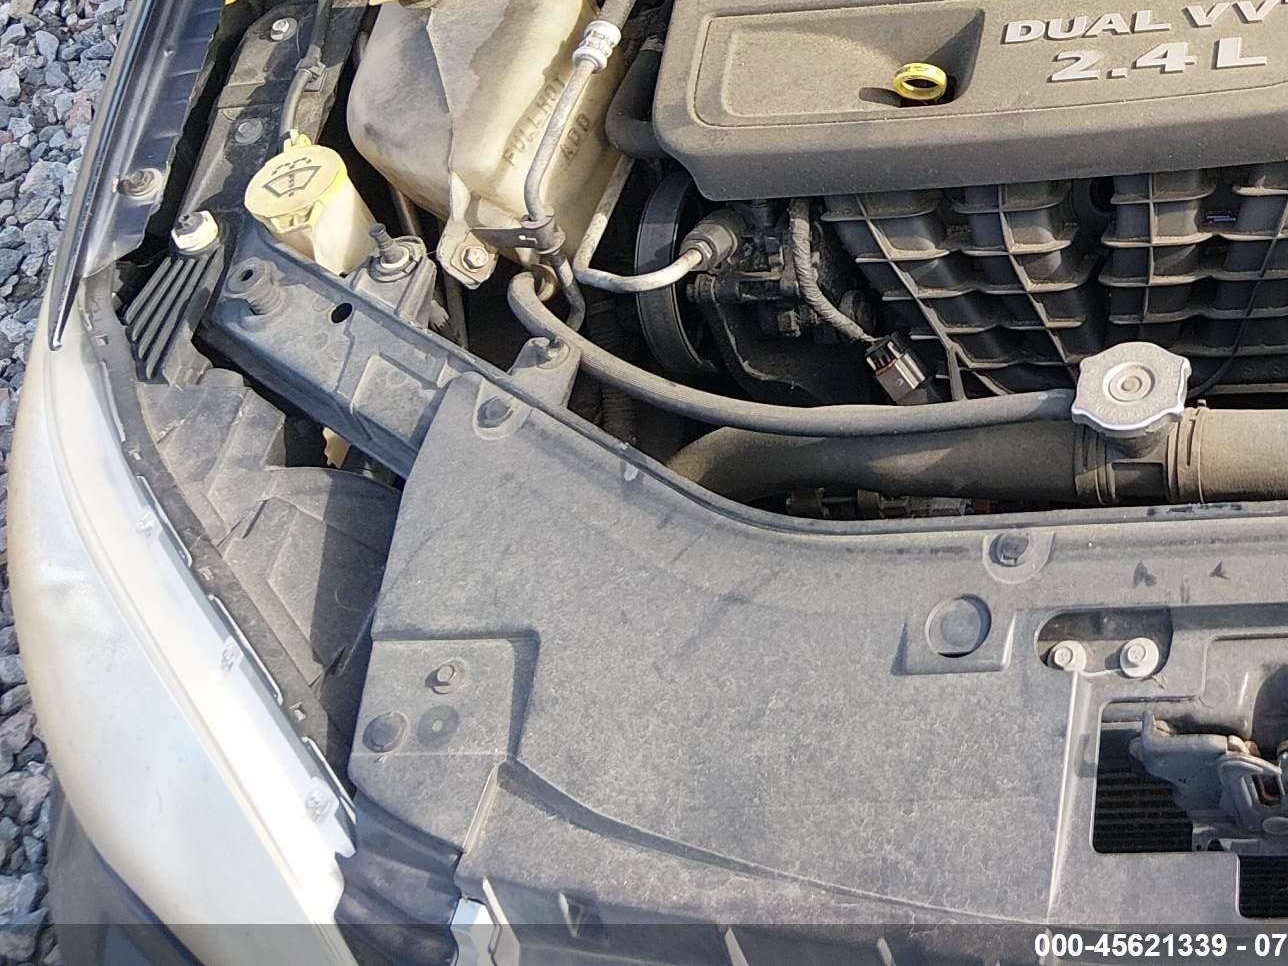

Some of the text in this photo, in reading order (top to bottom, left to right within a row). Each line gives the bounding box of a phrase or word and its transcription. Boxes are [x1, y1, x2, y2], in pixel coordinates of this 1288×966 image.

[1000, 8, 1172, 44] DUAL
[1048, 36, 1267, 83] 2.4 L
[502, 116, 541, 167] FULL
[560, 113, 592, 165] ADD
